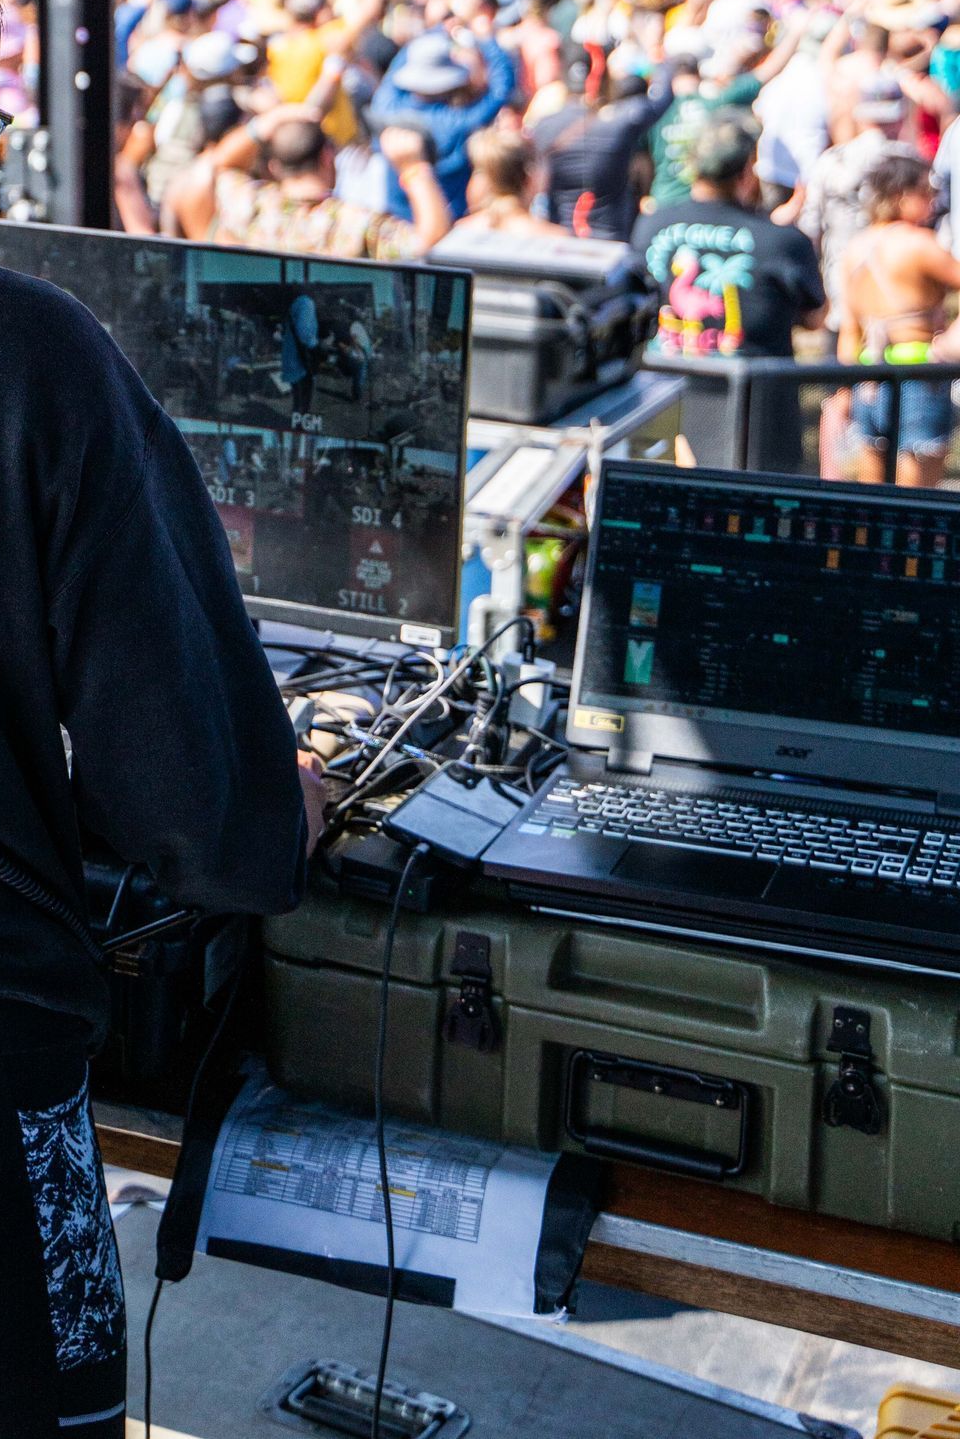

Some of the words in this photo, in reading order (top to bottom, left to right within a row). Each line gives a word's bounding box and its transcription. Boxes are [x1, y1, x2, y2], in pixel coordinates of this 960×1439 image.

[291, 412, 323, 432] PGM
[246, 490, 255, 507] 3
[351, 506, 382, 527] SDI
[391, 512, 402, 528] 4
[338, 588, 386, 613] STILL
[399, 598, 409, 615] 2
